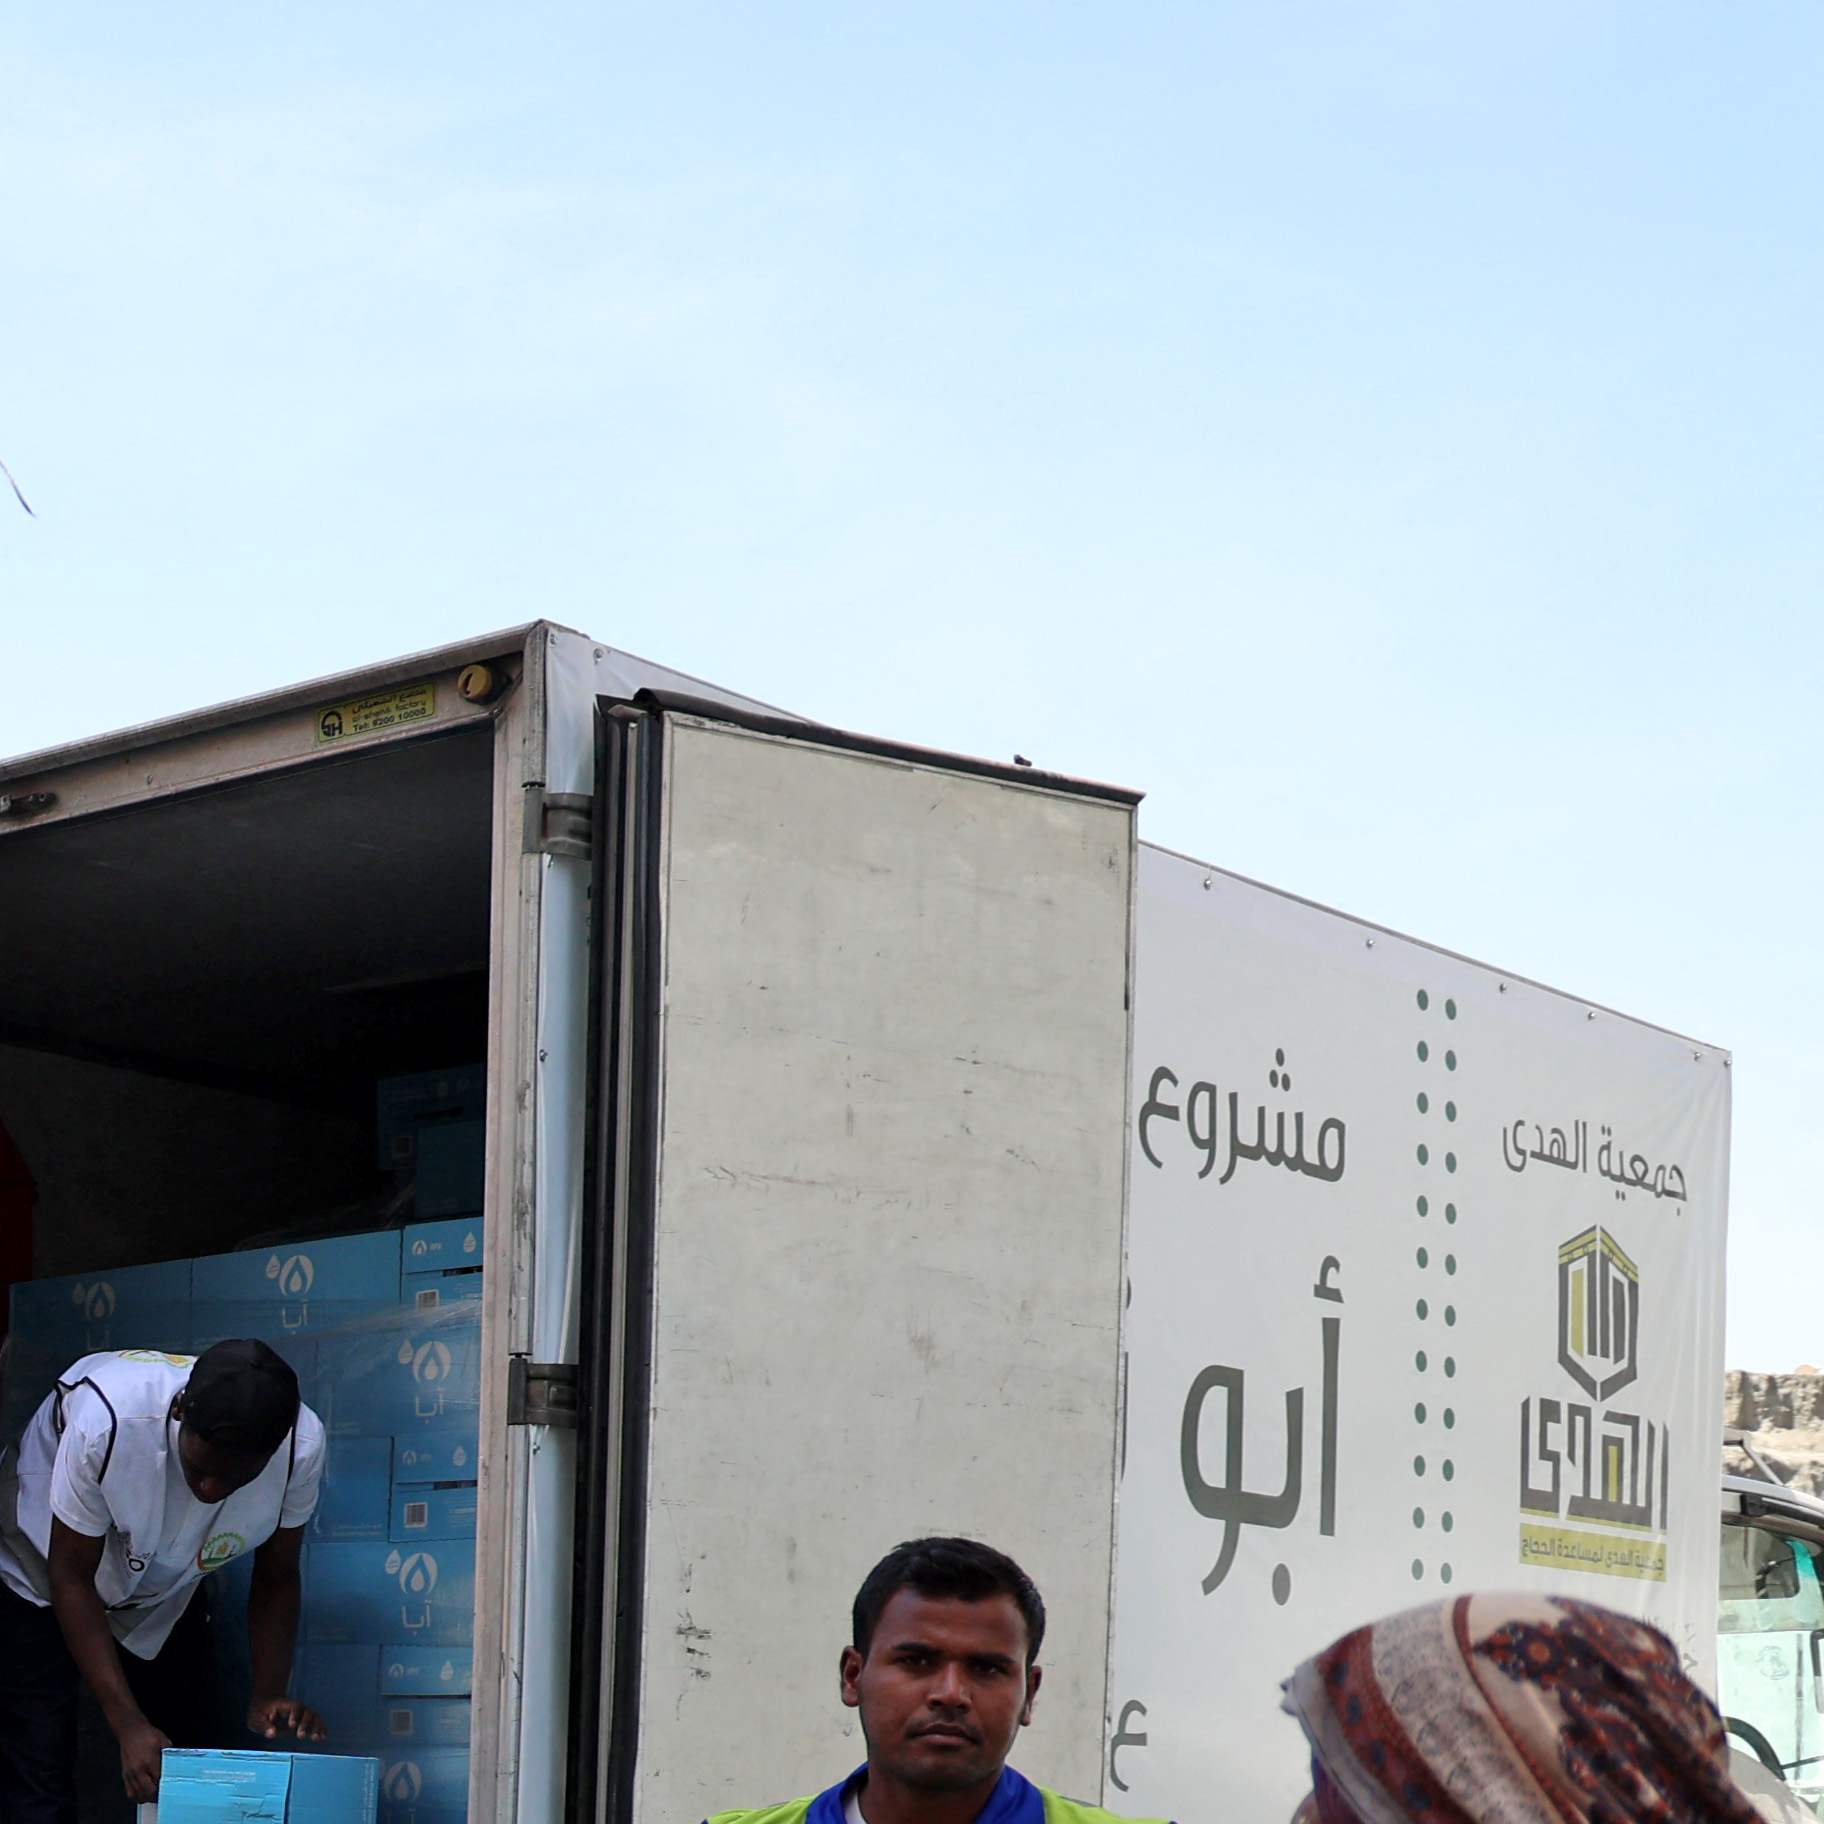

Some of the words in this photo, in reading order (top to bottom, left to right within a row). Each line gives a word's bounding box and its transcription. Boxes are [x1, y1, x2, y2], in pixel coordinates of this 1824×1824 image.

[1139, 1047, 1346, 1185] مشروع
[1503, 1119, 1588, 1174] الهدى
[1598, 1125, 1687, 1216] جمعية
[1181, 1255, 1345, 1606] أبو
[402, 1599, 432, 1636] آبا
